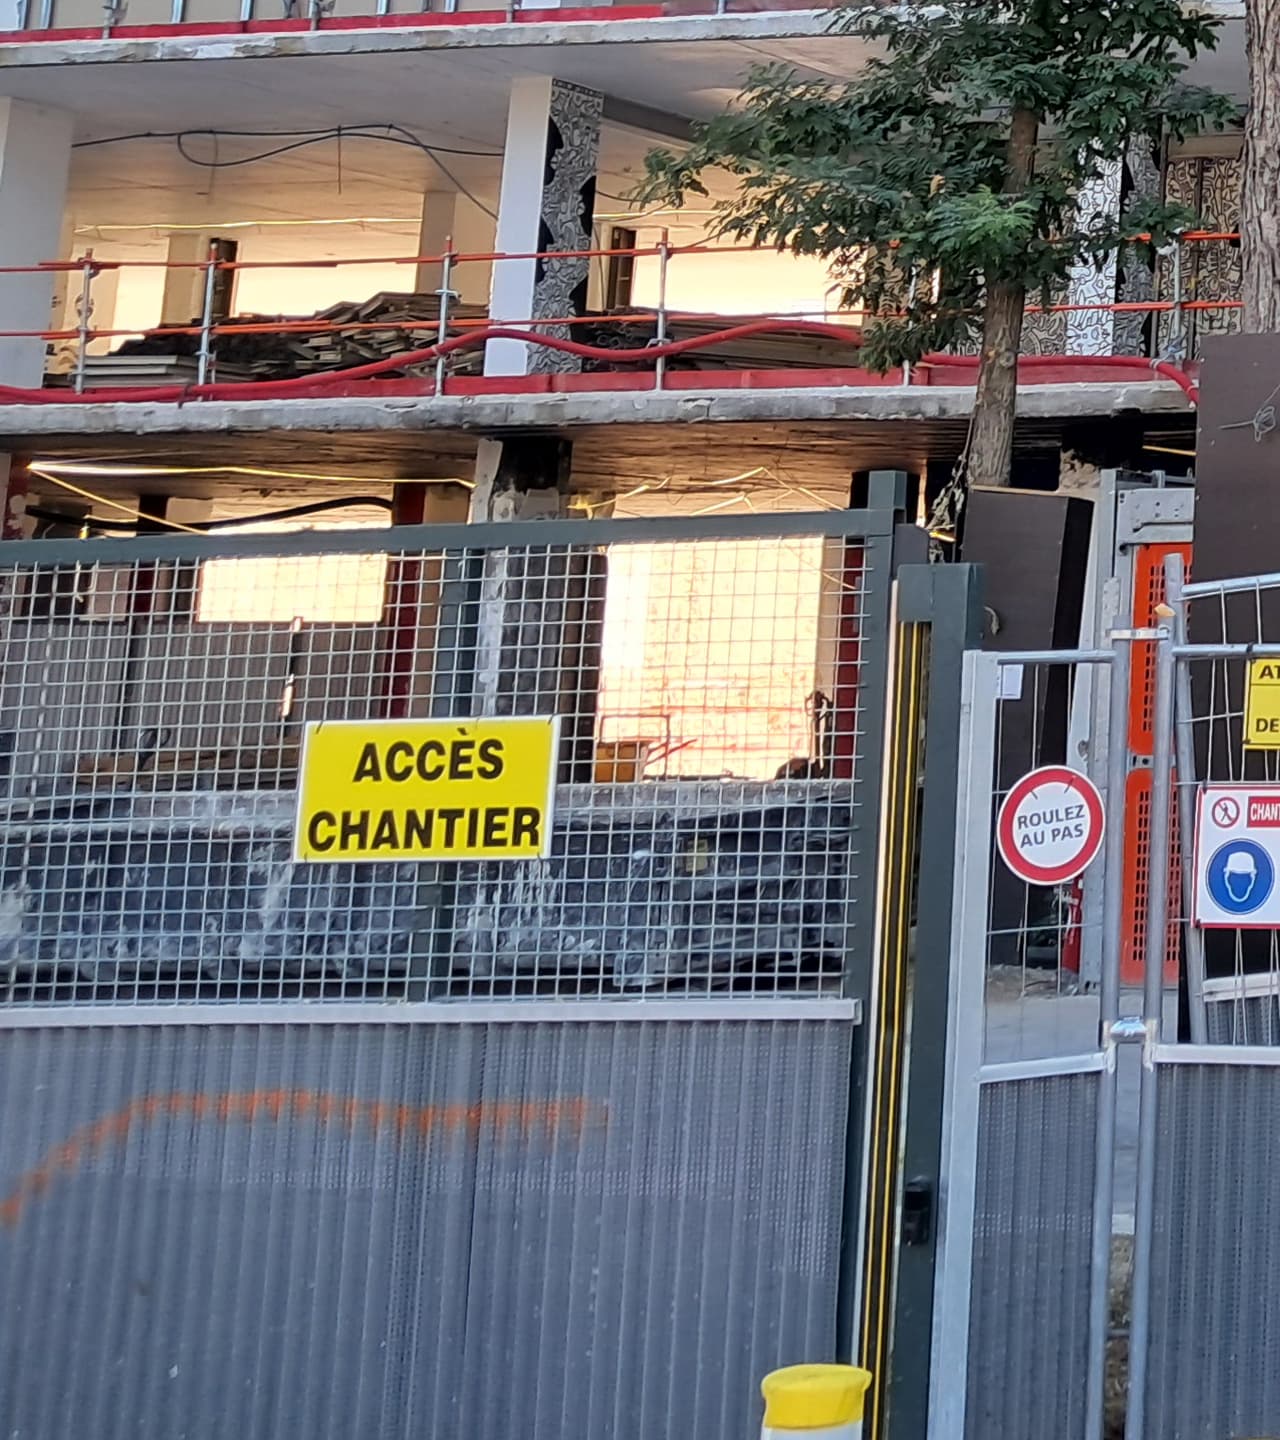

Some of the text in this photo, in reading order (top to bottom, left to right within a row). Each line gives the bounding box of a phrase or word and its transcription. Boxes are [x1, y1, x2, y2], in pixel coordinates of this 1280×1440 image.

[1255, 718, 1280, 733] DE
[352, 727, 504, 783] ACCÈS
[307, 806, 542, 852] CHANTIER
[1017, 804, 1086, 830] ROULEZ
[1019, 823, 1084, 849] AU PAS
